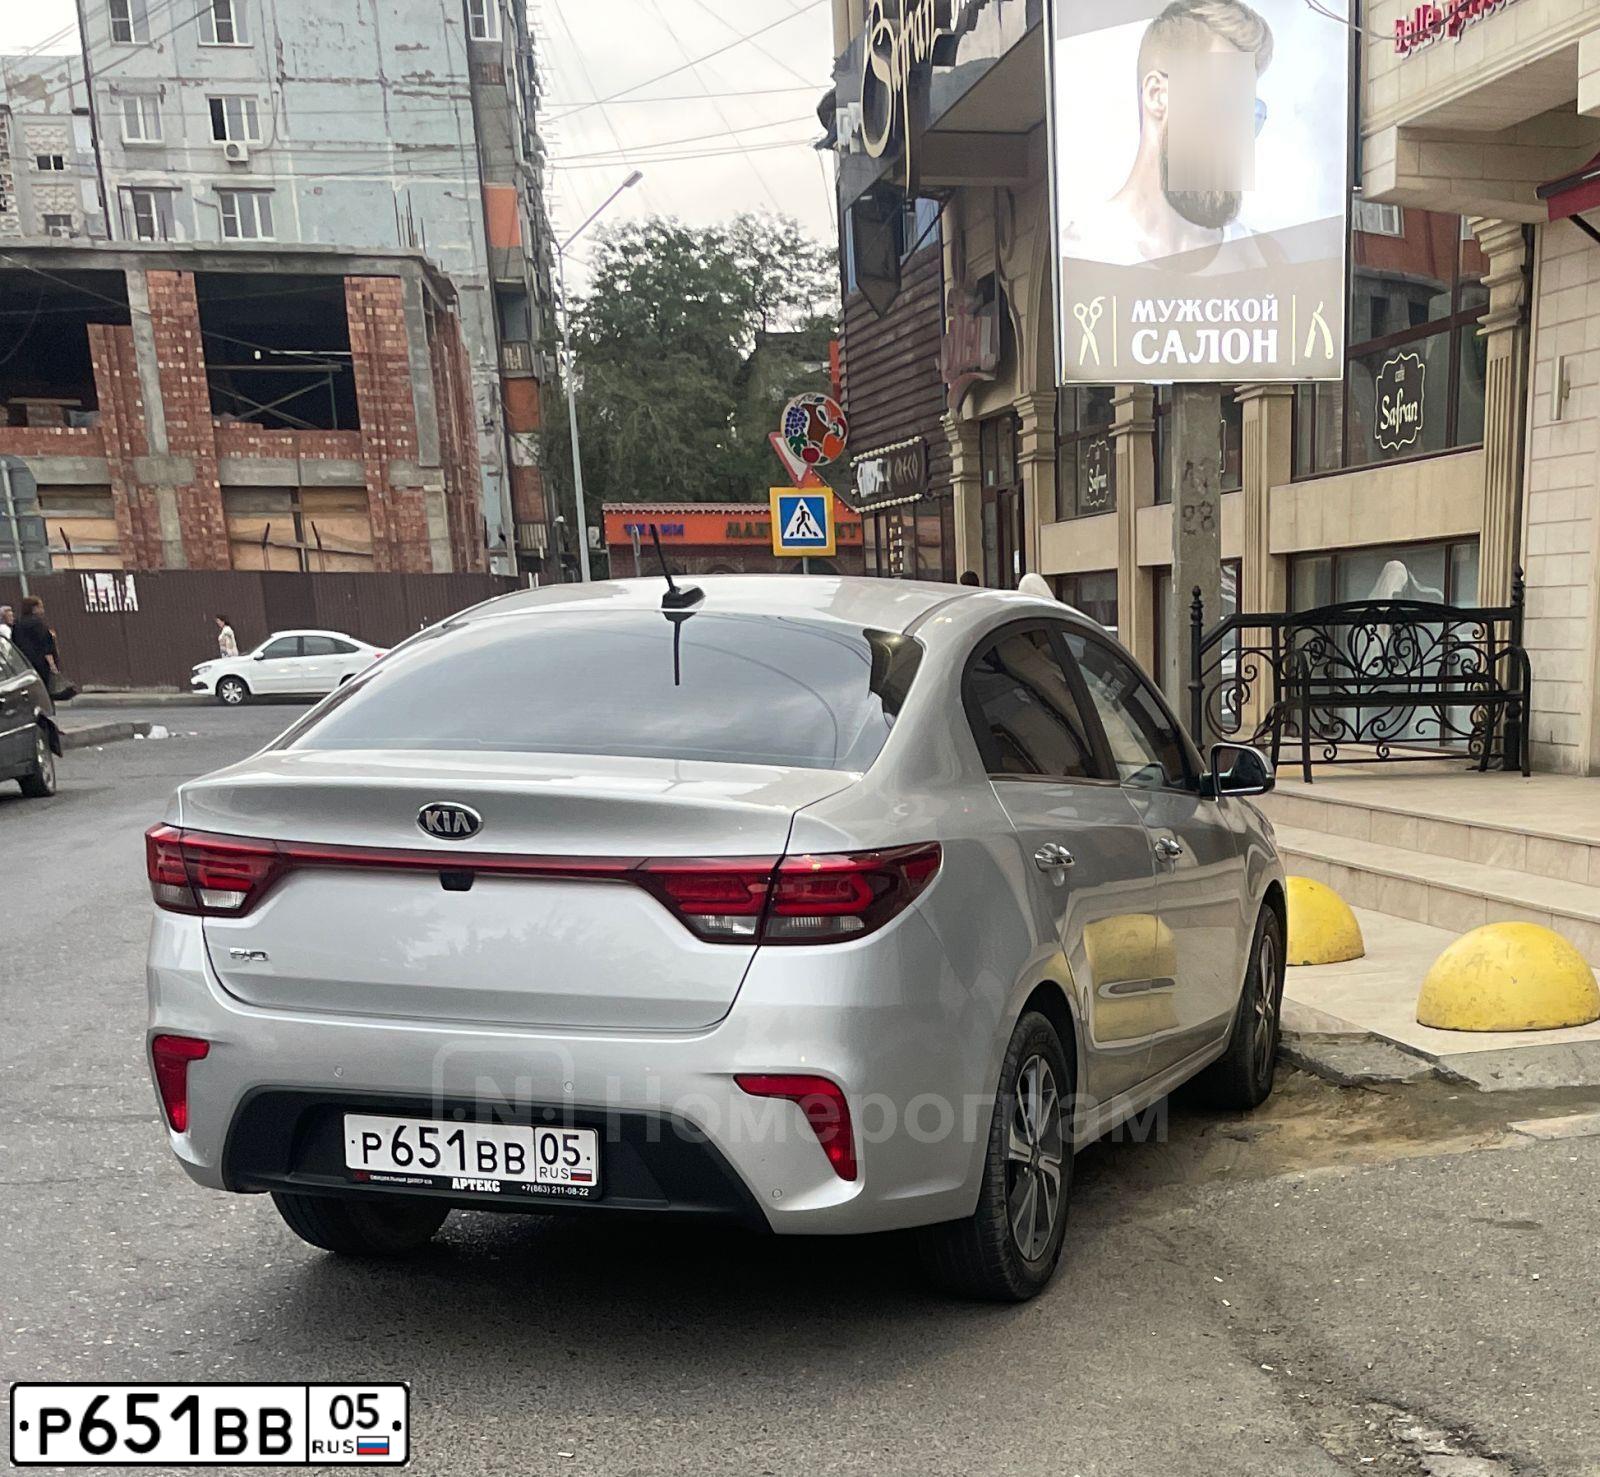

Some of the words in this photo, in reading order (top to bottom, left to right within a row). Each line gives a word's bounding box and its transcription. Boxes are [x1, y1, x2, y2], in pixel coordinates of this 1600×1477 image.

[1130, 294, 1279, 323] МУЖСКОЙ
[1131, 328, 1279, 365] САЛОН
[1380, 387, 1418, 434] Safran
[425, 810, 472, 833] KIA
[540, 1132, 581, 1166] 05
[451, 1178, 501, 1192] АРТЕКС
[539, 1167, 569, 1180] RUS
[551, 1186, 589, 1196] 211-08-22
